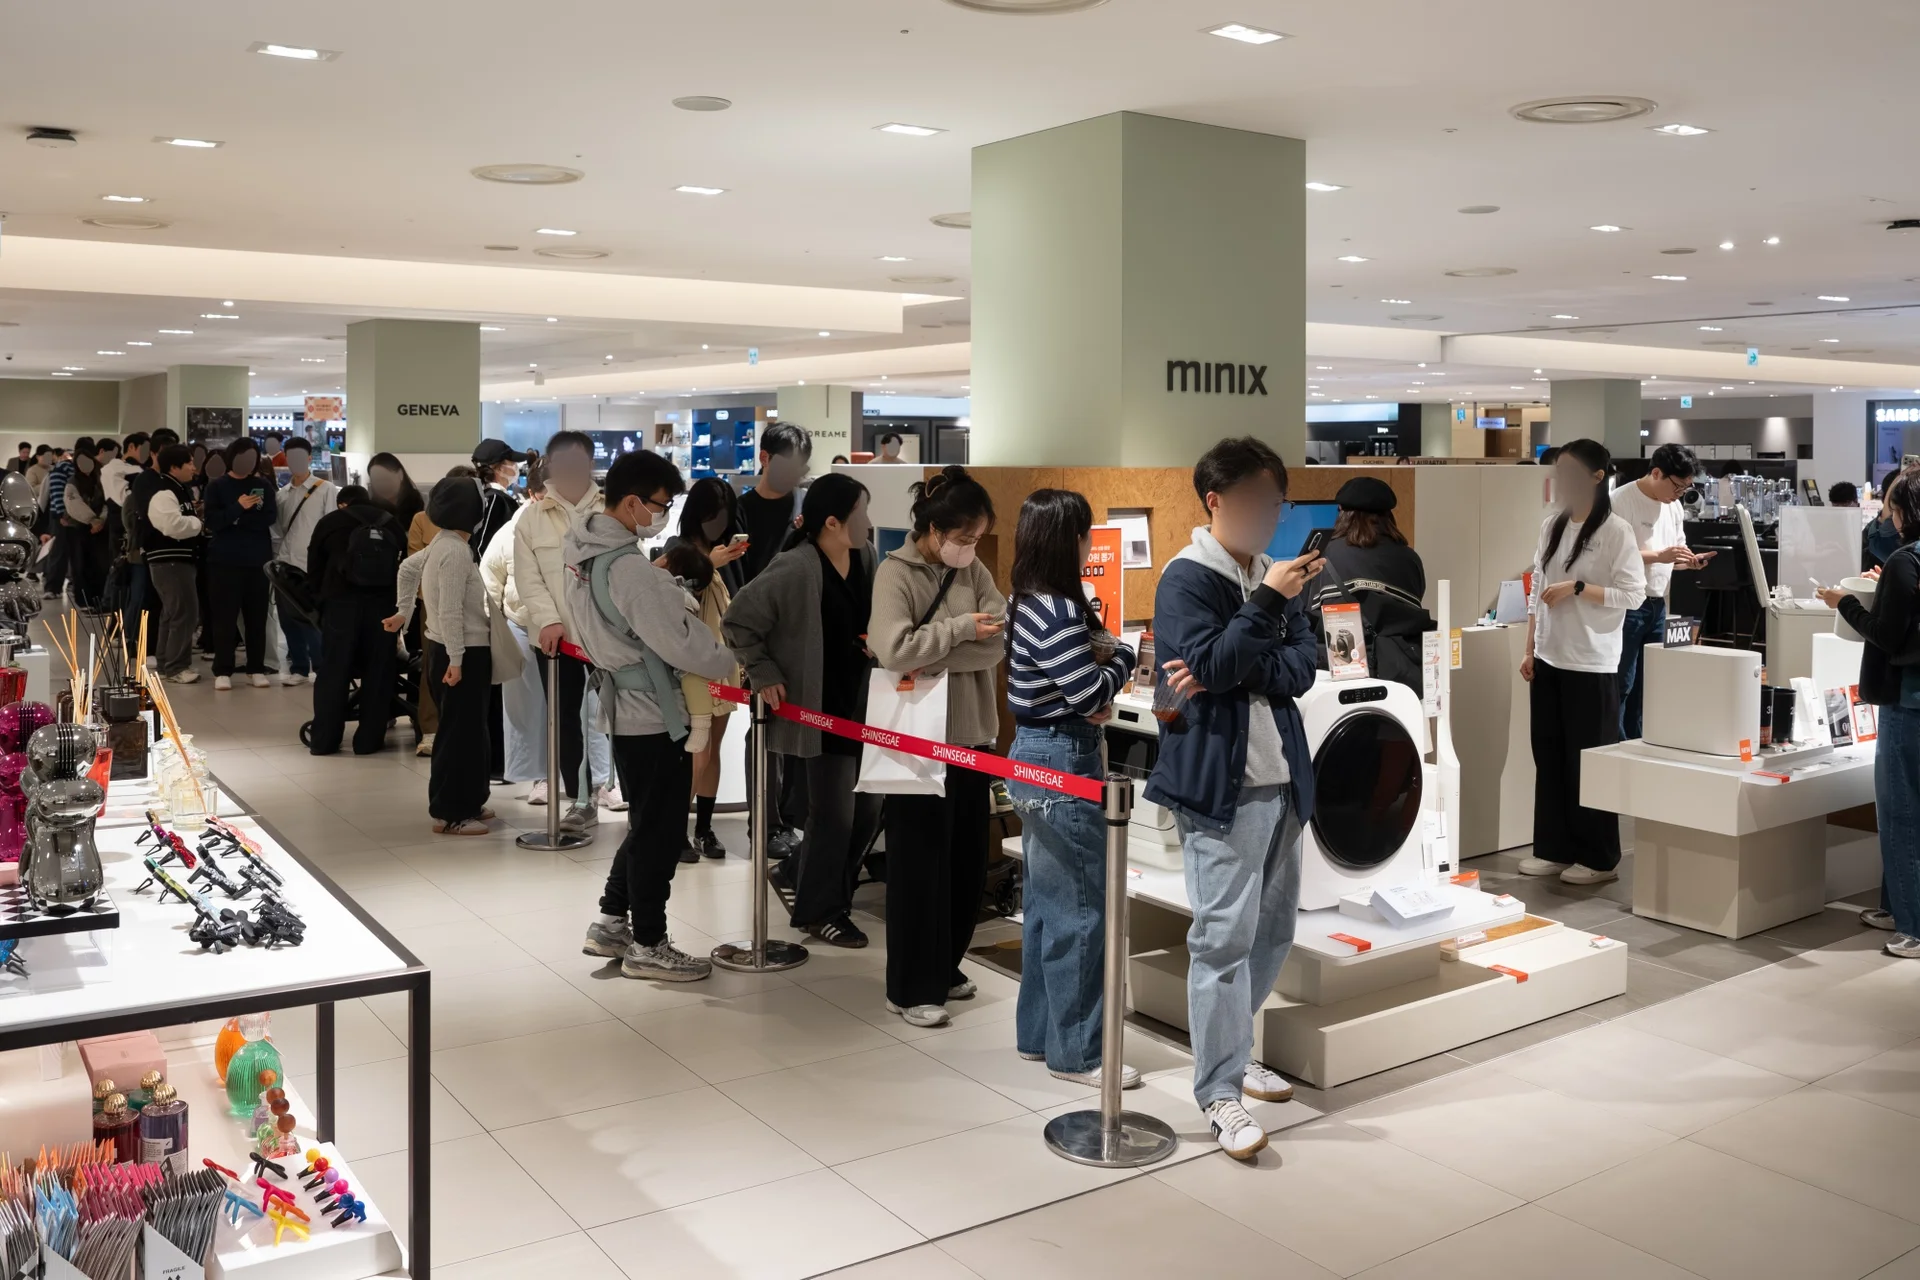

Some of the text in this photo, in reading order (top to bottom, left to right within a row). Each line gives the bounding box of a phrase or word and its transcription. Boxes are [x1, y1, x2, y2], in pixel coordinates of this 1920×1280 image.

[1167, 360, 1268, 396] minix
[397, 404, 460, 416] GENEVA
[1876, 408, 1920, 422] SAMS
[1666, 626, 1691, 644] MAX
[800, 710, 833, 729] SHINSEGAE
[861, 728, 900, 748] SHINSEGAE
[932, 745, 976, 766] SHINSEGAE
[1014, 764, 1063, 788] SHINSEGAE
[162, 1265, 186, 1274] FRAGILE
